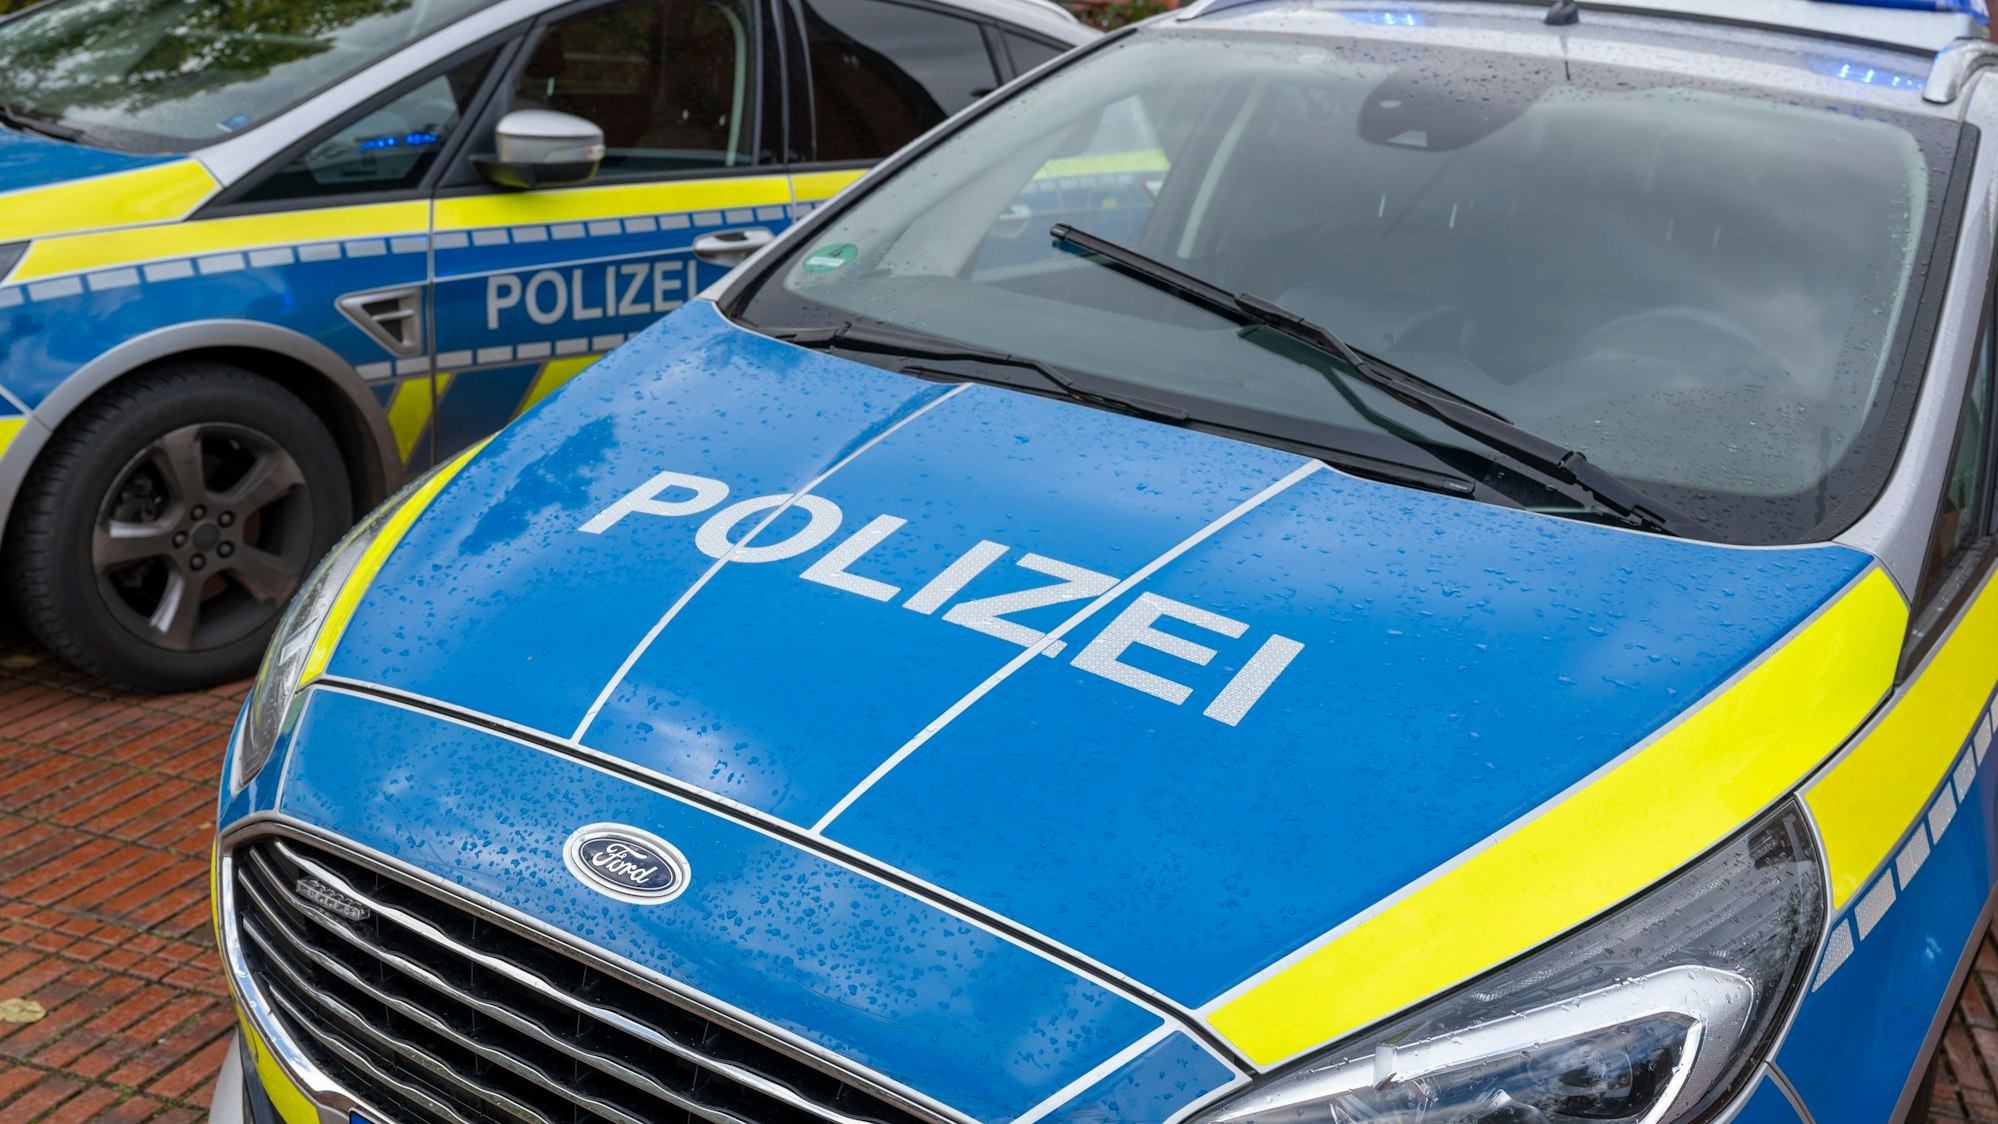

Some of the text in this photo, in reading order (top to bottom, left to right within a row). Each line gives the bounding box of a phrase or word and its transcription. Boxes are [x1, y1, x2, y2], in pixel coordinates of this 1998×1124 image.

[486, 259, 698, 330] POLIZEI
[577, 470, 1305, 727] POLIZEI
[592, 843, 658, 884] Ford
